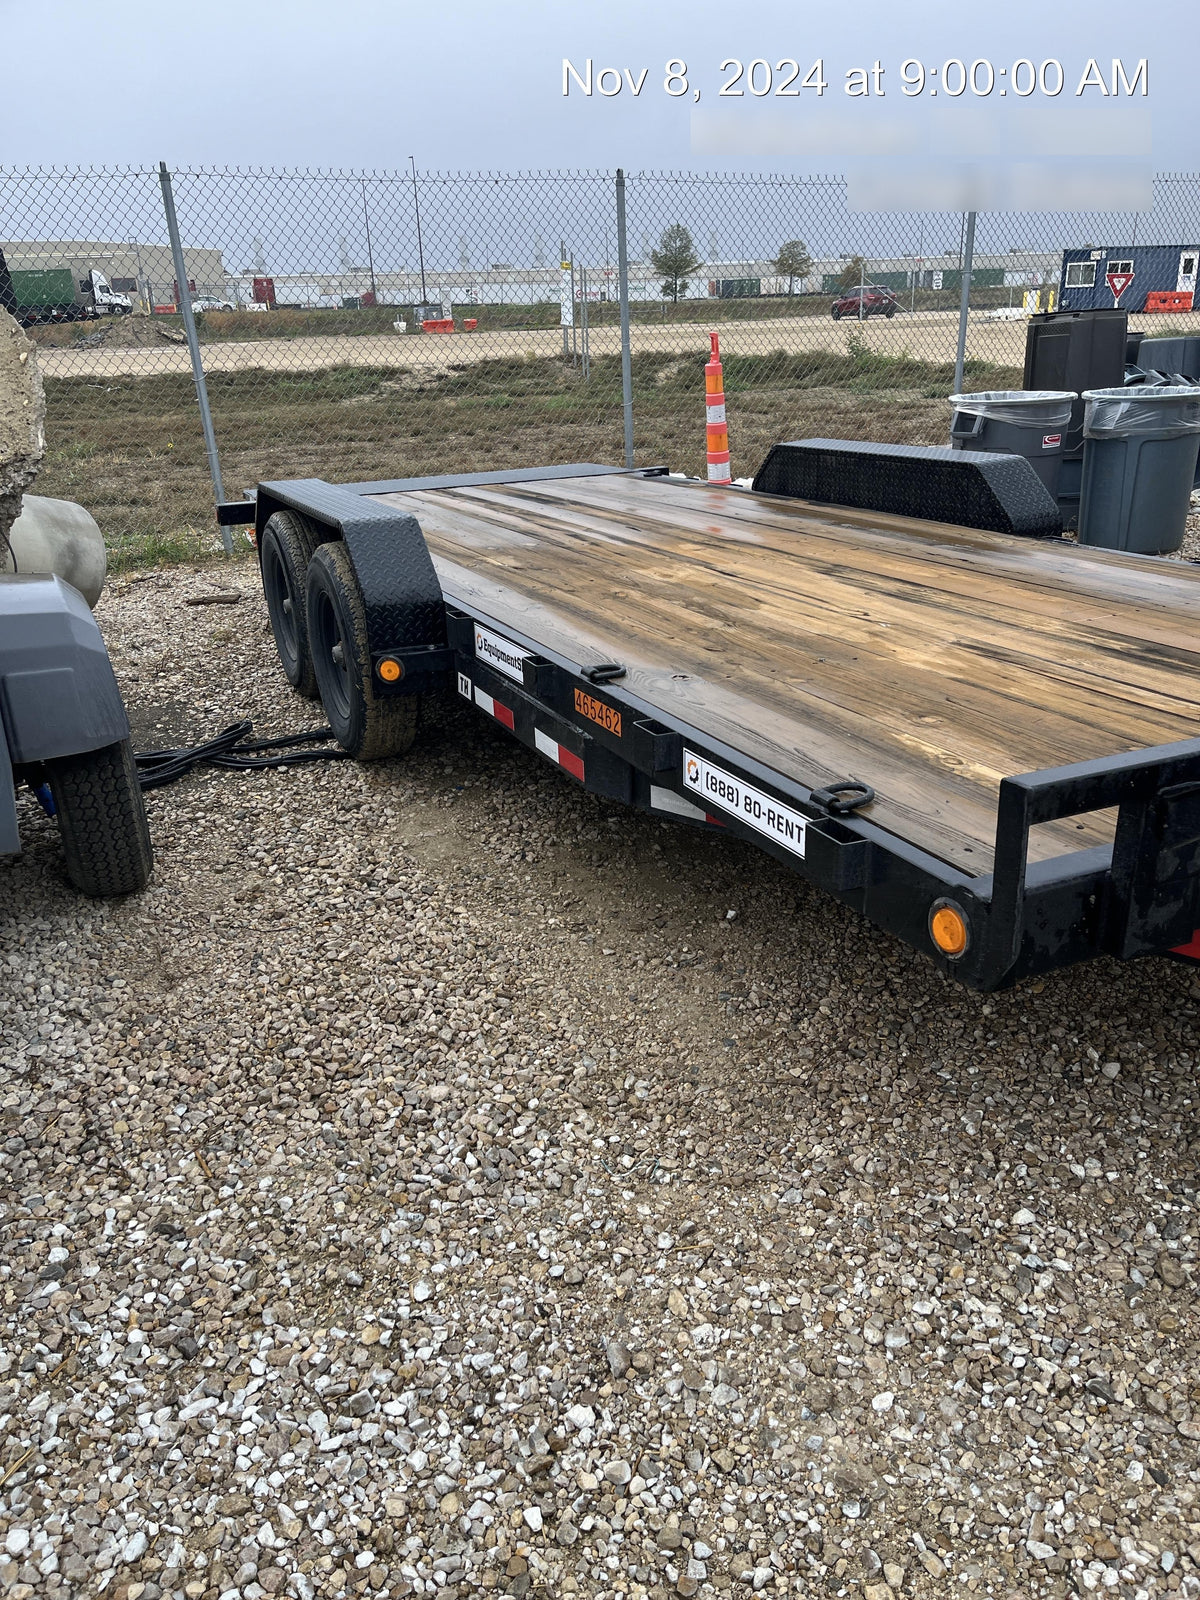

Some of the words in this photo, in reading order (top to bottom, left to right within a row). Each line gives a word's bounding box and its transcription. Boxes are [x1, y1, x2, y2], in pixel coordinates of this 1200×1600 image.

[483, 638, 523, 672] EquipmentS
[575, 691, 620, 734] 465462
[706, 771, 739, 807] (888)
[744, 795, 804, 843] 80-RENT
